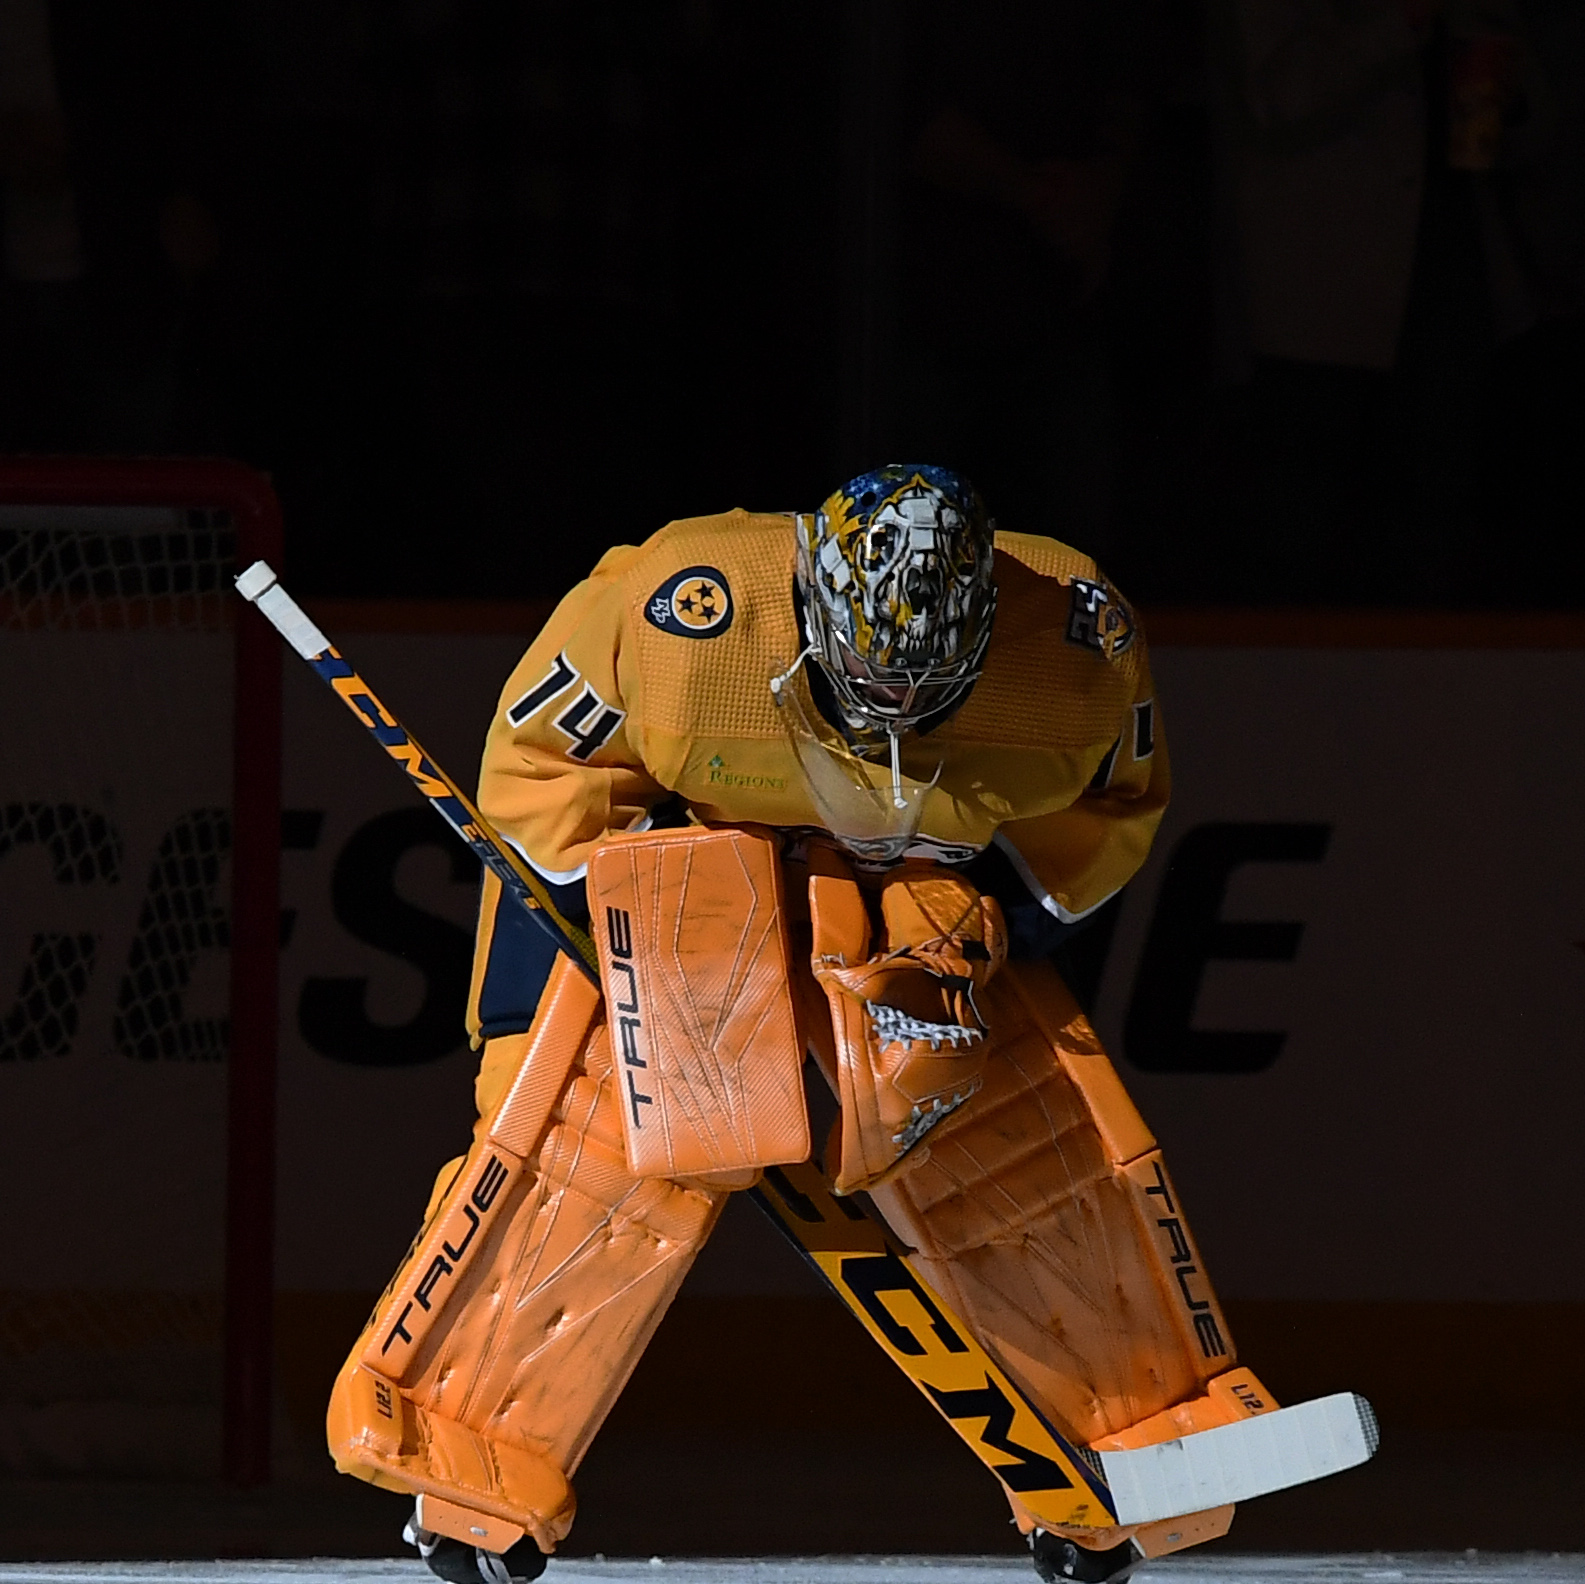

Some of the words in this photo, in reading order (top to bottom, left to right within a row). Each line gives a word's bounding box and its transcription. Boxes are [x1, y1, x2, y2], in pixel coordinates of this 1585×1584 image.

[313, 644, 454, 800] CM
[506, 651, 627, 763] 74
[605, 905, 653, 1130] TRUE
[381, 1154, 509, 1357] TRUE
[1144, 1160, 1227, 1358] TRUE
